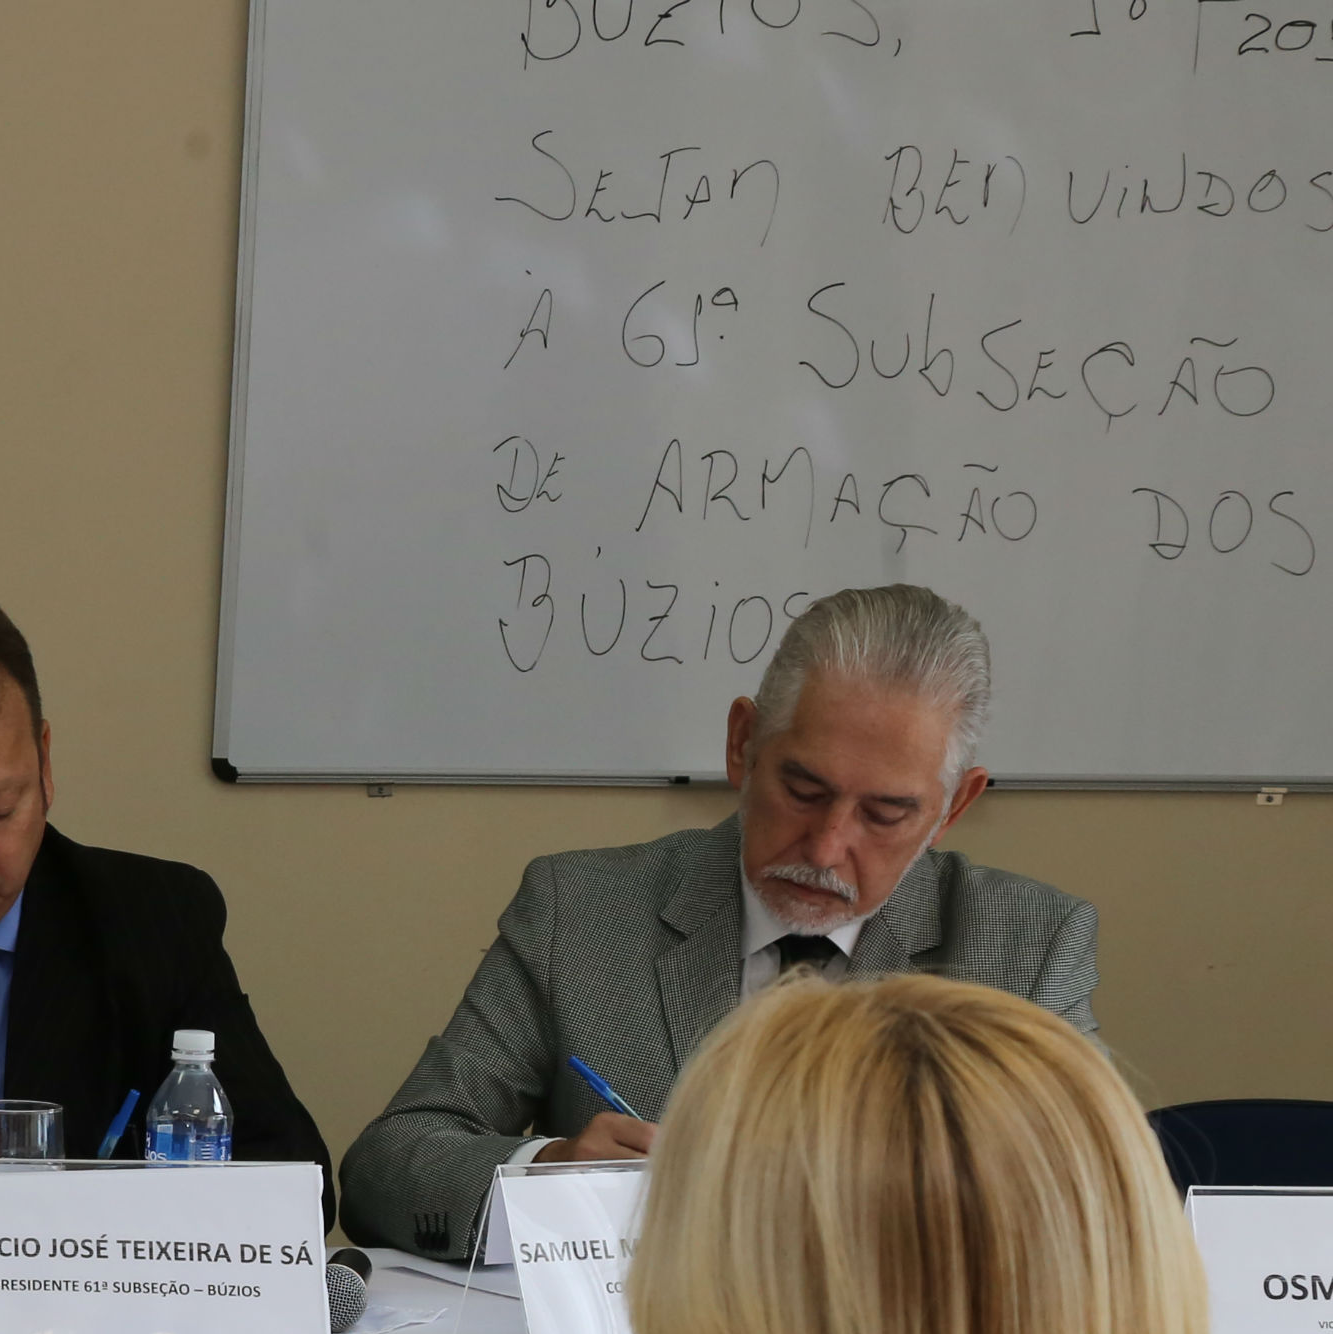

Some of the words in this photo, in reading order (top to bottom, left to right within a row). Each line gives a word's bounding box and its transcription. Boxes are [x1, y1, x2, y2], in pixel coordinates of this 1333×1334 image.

[493, 436, 565, 513] DE
[636, 438, 1037, 553] ARMAÇÃO
[1132, 488, 1315, 576] DOS
[48, 1234, 109, 1260] JOSÉ
[116, 1239, 232, 1264] TEIXEIRA
[240, 1243, 272, 1265] DE
[280, 1240, 314, 1266] SÁ
[520, 1239, 615, 1264] SAMUEL
[84, 1280, 109, 1293] 61ª
[113, 1279, 190, 1297] SUBSEÇÃO
[207, 1281, 261, 1298] BÚZIOS
[1263, 1274, 1333, 1300] OSM
